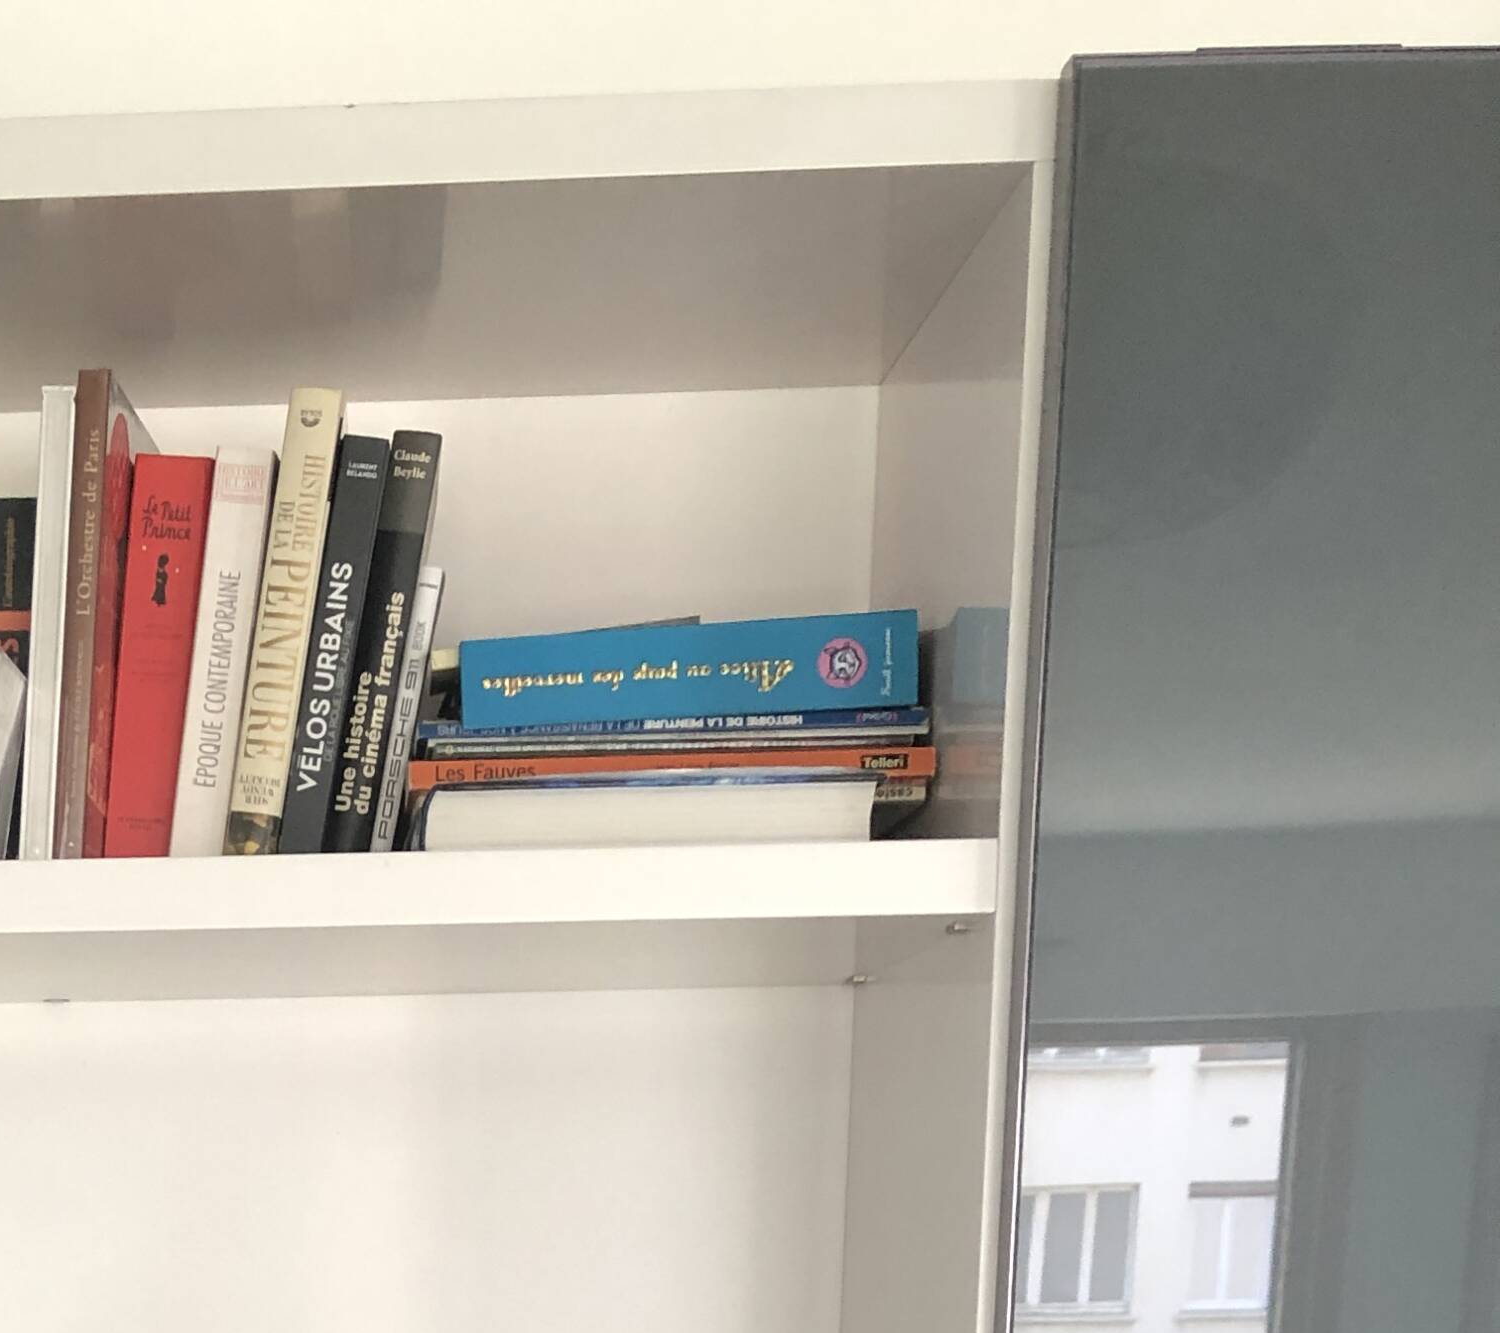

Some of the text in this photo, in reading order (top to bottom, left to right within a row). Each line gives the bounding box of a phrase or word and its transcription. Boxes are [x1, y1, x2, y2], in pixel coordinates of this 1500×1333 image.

[393, 448, 432, 464] Claude
[393, 465, 427, 481] Beylie
[161, 499, 193, 522] Petit
[291, 453, 327, 553] HISTOIRE
[75, 429, 100, 617] L'Orchestre de Paris
[141, 517, 192, 541] Prince
[273, 500, 297, 551] DE LA
[203, 570, 242, 715] CONTEMPORAINE
[311, 561, 353, 692] URBAINS
[243, 556, 312, 761] PEINTURE
[482, 660, 795, 698] Alice au pays des merveilles
[354, 591, 405, 816] du cinéma français
[704, 717, 723, 728] LA
[725, 716, 744, 728] DE
[746, 714, 804, 727] HISTOIRE
[335, 671, 373, 812] Une histoire
[642, 718, 704, 731] PEINTURE
[378, 696, 414, 840] PORSCHE
[404, 658, 421, 691] 911
[435, 762, 537, 782] Les Fauves
